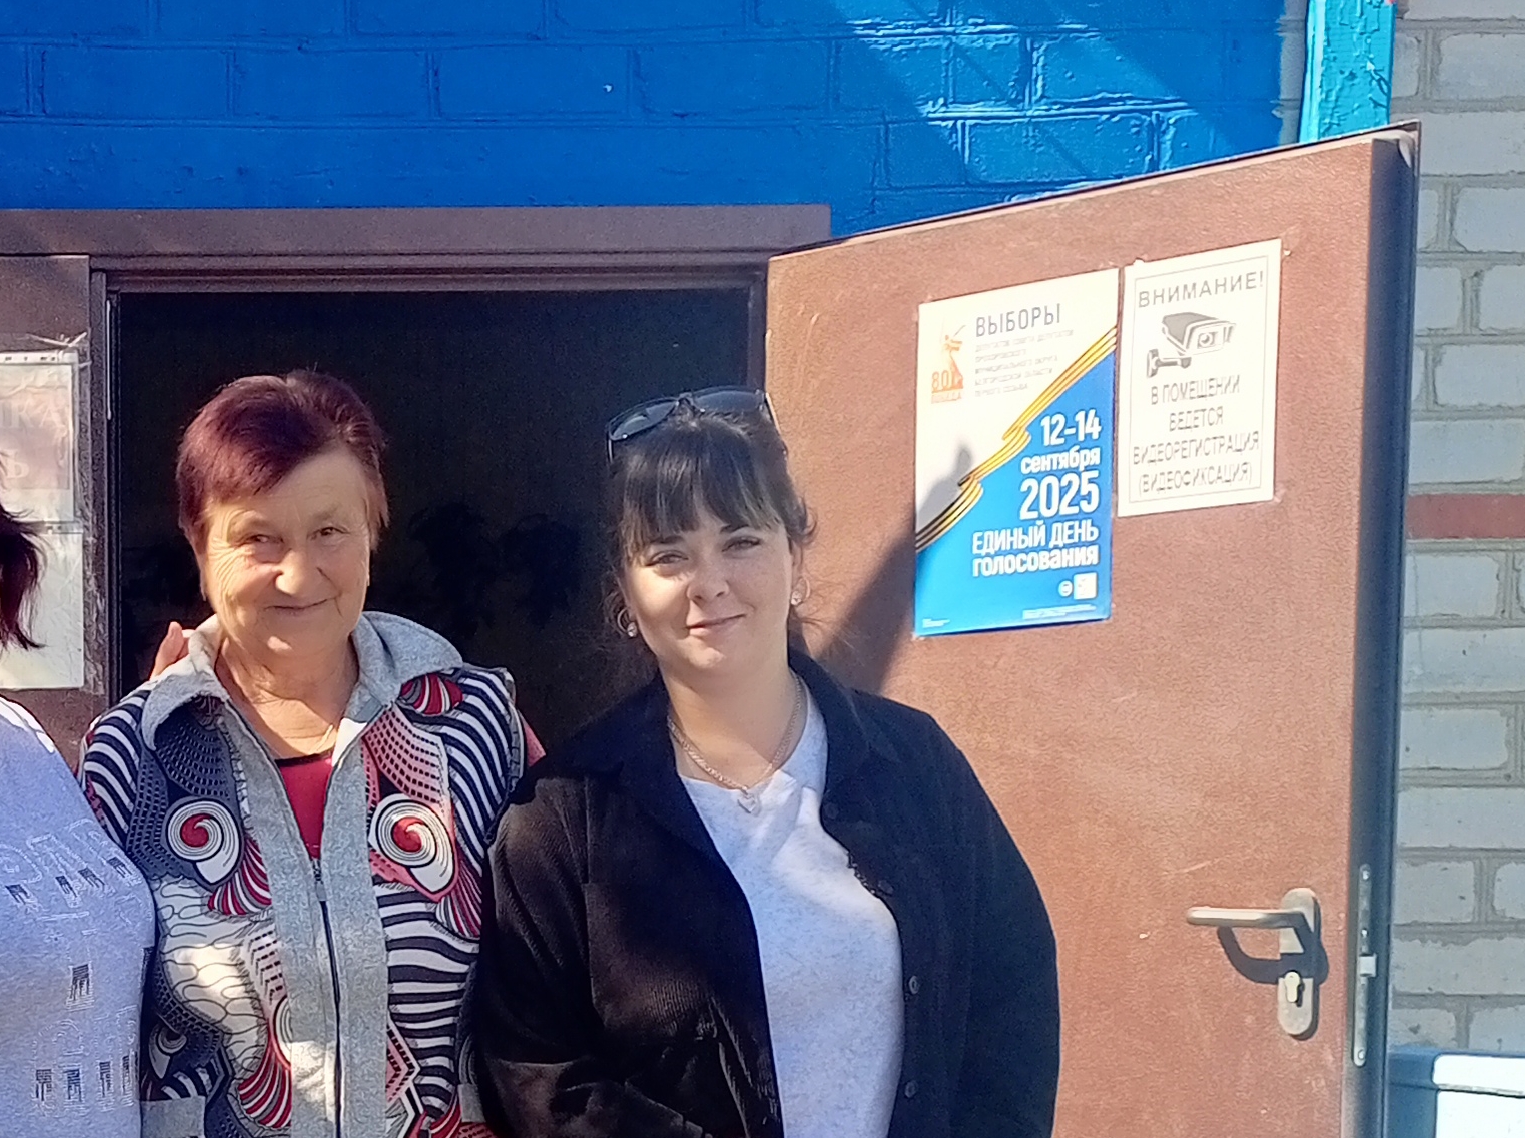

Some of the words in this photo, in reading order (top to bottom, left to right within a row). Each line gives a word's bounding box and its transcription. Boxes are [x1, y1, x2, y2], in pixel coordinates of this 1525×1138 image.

[1138, 270, 1264, 308] ВНИМАНИЕ!
[975, 303, 1061, 337] ВЫБОРЫ
[1151, 386, 1159, 406] В
[1162, 374, 1241, 403] ПОМЕЩЕНИИ
[1040, 409, 1102, 446] 12-14
[1169, 406, 1224, 432] ВЕДЕТСЯ
[1020, 445, 1101, 475] сентября
[1133, 431, 1260, 466] ВИДЕОРЕГИСТРАЦИЯ
[1019, 469, 1100, 520] 2025
[972, 520, 1046, 555] ЕДИНЫЙ
[1048, 519, 1100, 549] ДЕНЬ
[972, 544, 1100, 577] голосования
